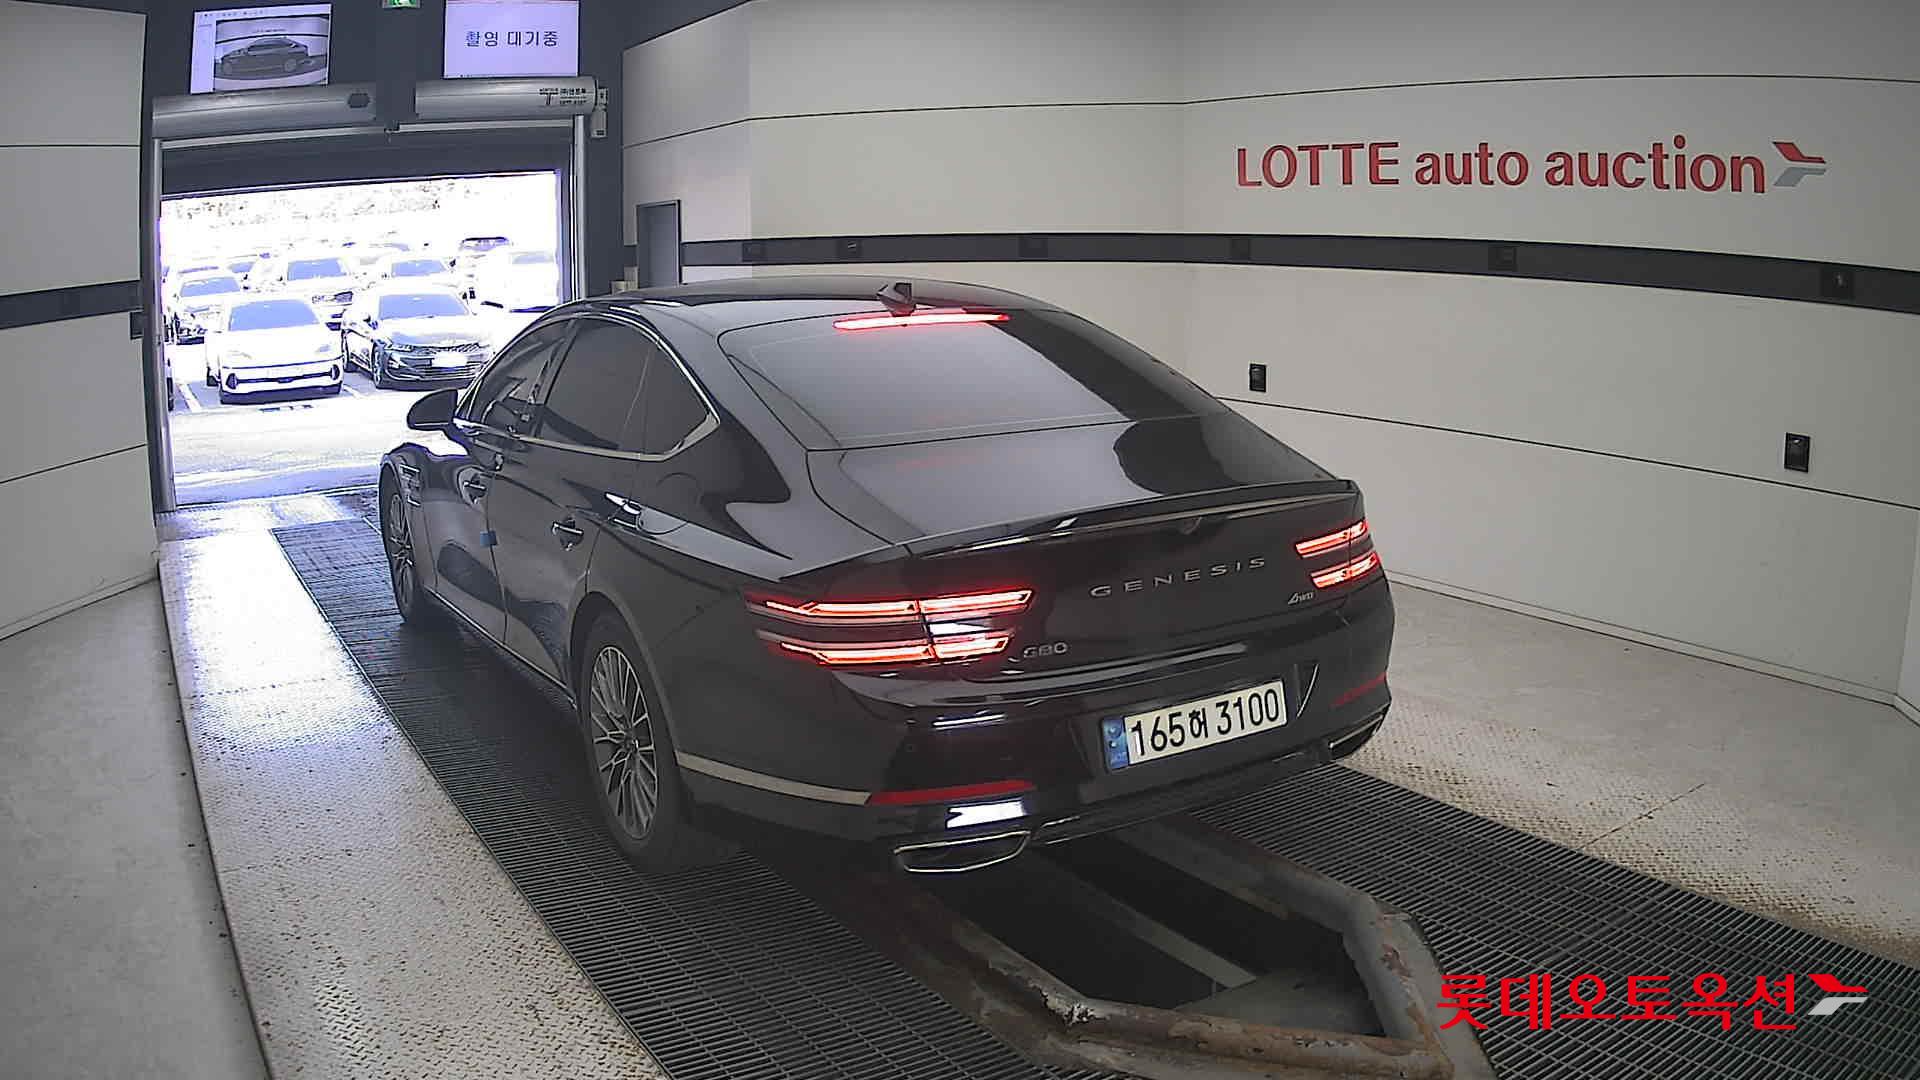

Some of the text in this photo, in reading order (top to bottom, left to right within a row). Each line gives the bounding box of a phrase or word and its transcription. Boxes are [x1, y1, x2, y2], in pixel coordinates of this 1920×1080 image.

[507, 31, 558, 47] 대기중
[1237, 134, 1765, 193] LOTTE auto auction
[1090, 557, 1265, 597] GENESIS
[1023, 642, 1068, 658] G80
[1215, 689, 1280, 735] 3100
